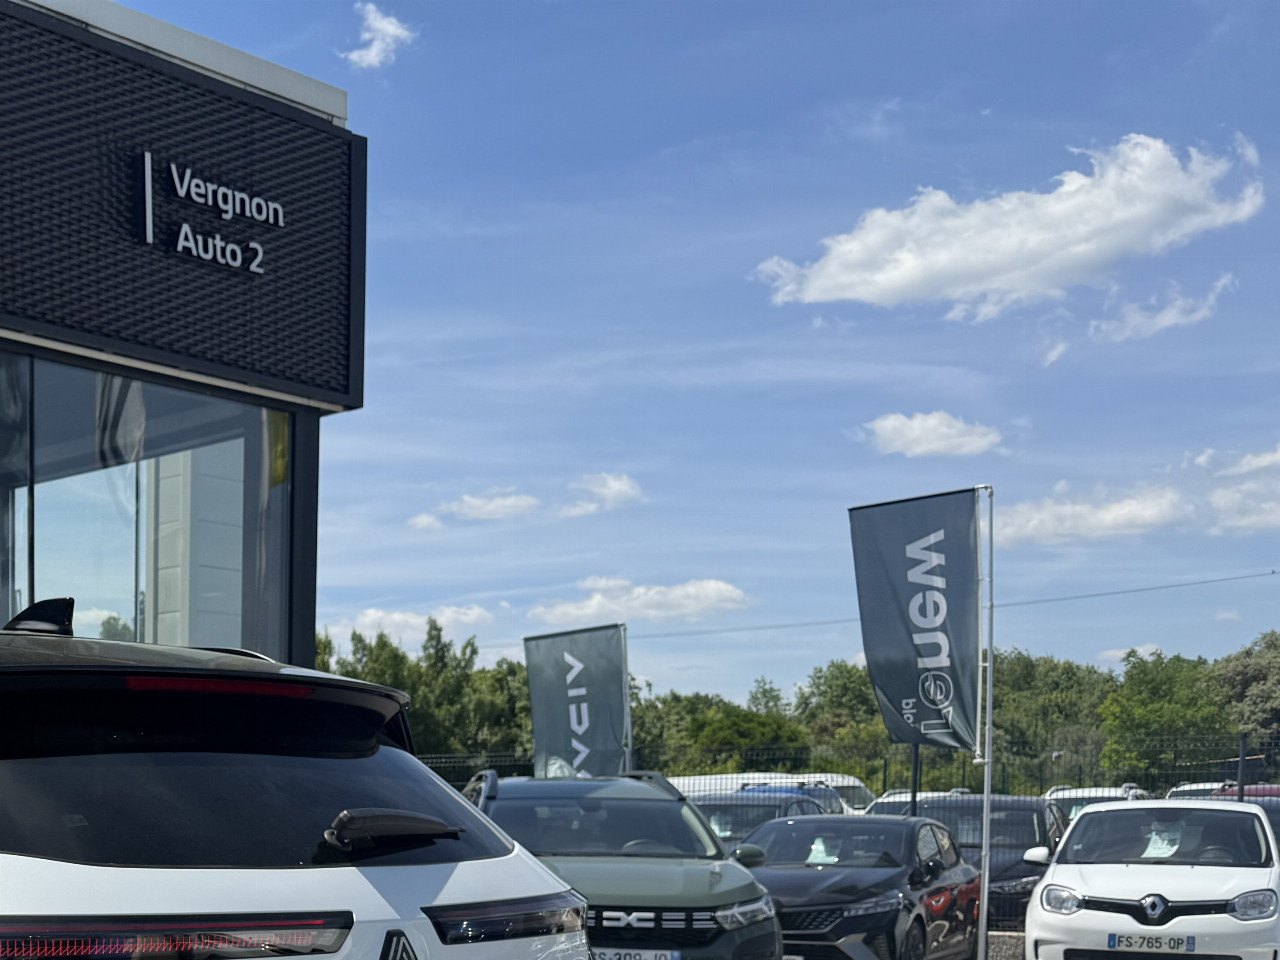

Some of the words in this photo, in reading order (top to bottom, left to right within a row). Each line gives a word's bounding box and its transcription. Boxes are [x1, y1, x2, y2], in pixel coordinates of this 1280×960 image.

[170, 163, 285, 227] Vergnon
[177, 223, 242, 267] Auto
[249, 242, 265, 274] 2
[1118, 936, 1193, 952] FS-765-QP
